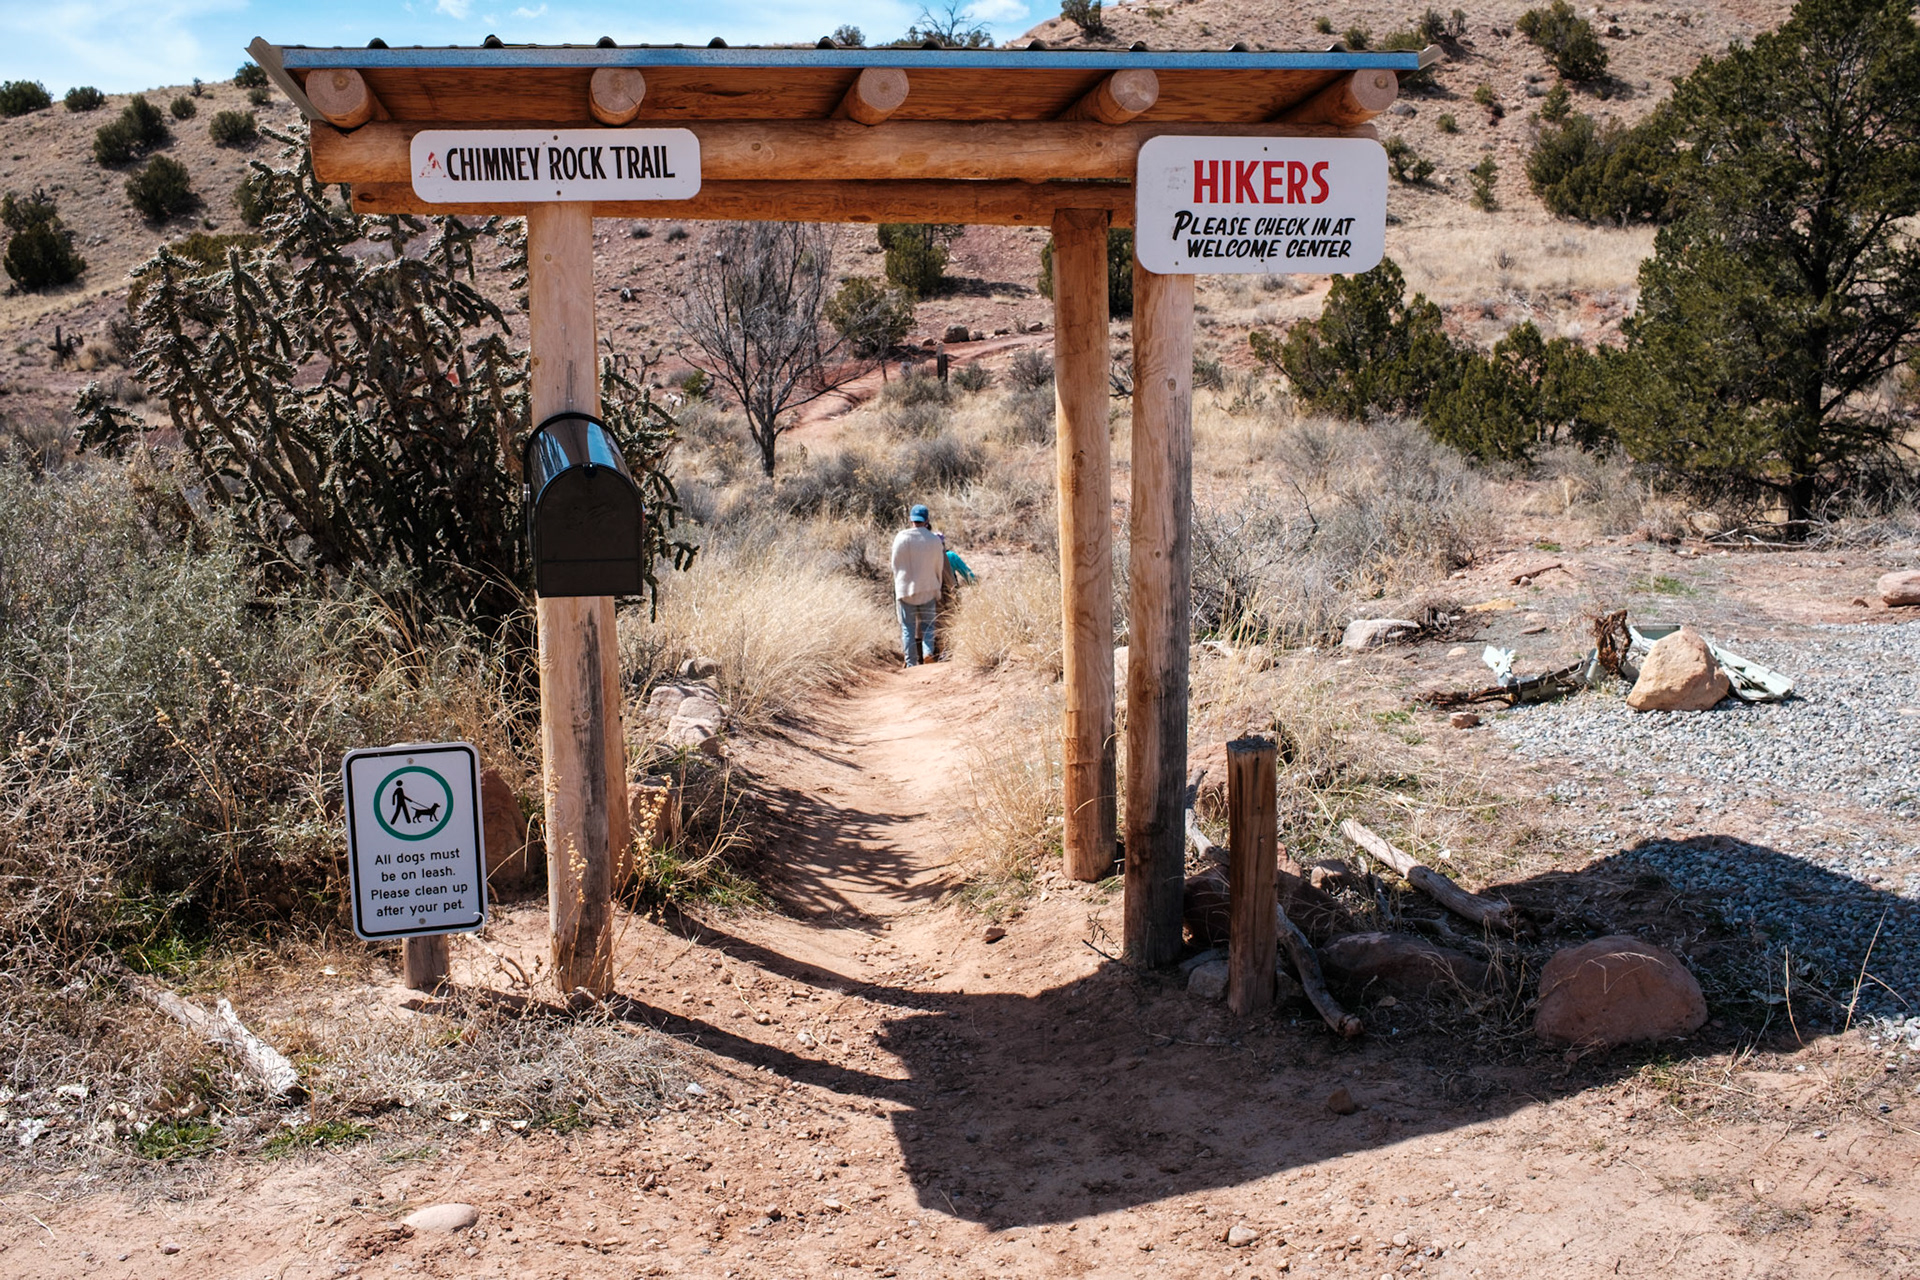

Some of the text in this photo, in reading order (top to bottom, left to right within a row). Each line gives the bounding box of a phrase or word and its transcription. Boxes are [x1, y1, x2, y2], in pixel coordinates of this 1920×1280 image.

[446, 146, 676, 181] CHIMNEY ROCK TRAIL
[1193, 160, 1330, 204] HIKERS
[1172, 210, 1355, 241] PLEASE CHECK IN AT
[1187, 239, 1352, 258] WELCOME CENTER
[375, 848, 460, 865] All dogs must
[381, 867, 456, 882] be on leash.
[371, 883, 468, 900] Please clean up
[376, 899, 464, 917] after your pet.
